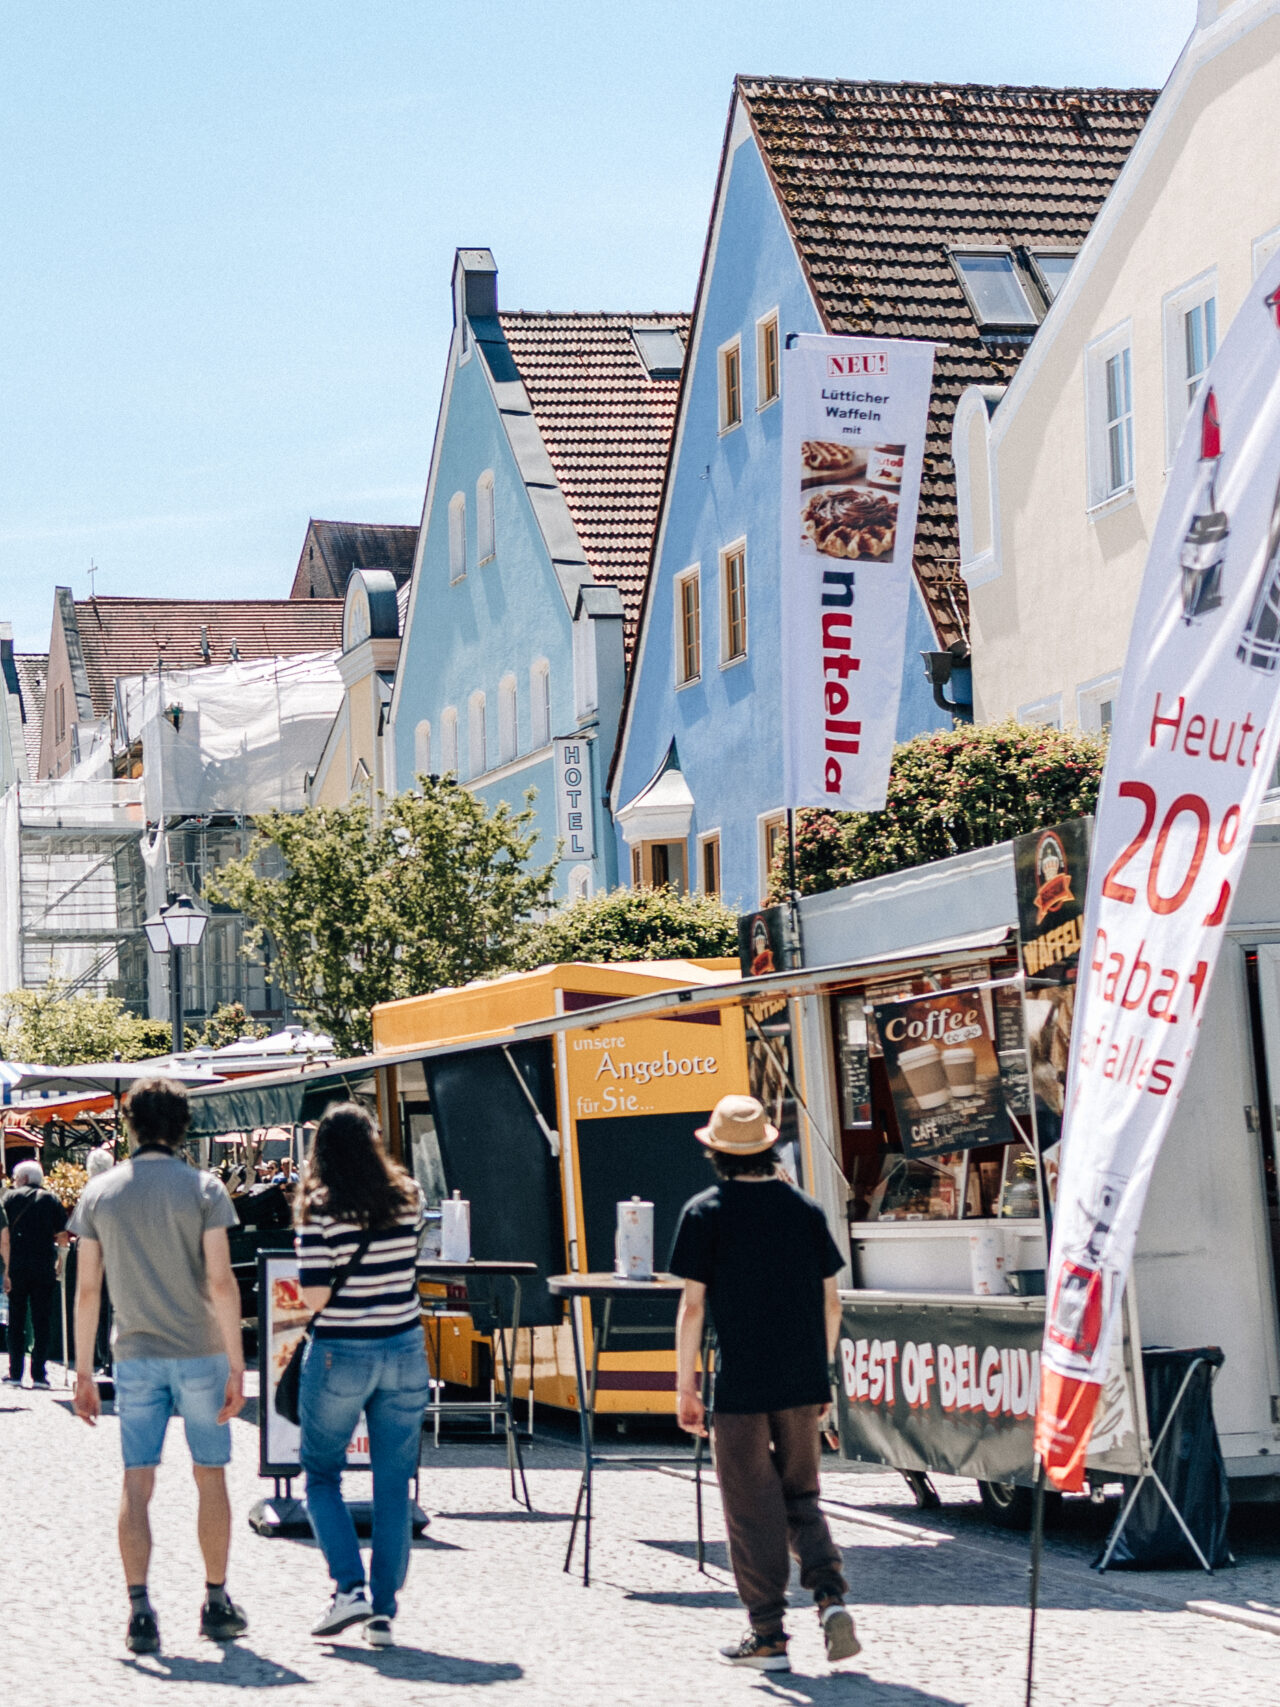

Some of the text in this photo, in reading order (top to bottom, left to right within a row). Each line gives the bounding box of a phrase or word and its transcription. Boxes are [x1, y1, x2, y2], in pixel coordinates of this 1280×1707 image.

[830, 356, 885, 374] NEU!
[821, 389, 890, 404] Lütticher
[826, 407, 881, 421] Waffeln
[842, 426, 862, 435] mit
[821, 571, 861, 794] nutella
[565, 746, 584, 852] HOTEL
[1091, 928, 1209, 1027] Rabat
[885, 1009, 978, 1042] Coffee
[573, 1036, 625, 1050] unsere
[595, 1051, 719, 1084] Angebote
[576, 1087, 655, 1117] für Sie...
[840, 1338, 898, 1408] BEST
[901, 1341, 935, 1409] OF
